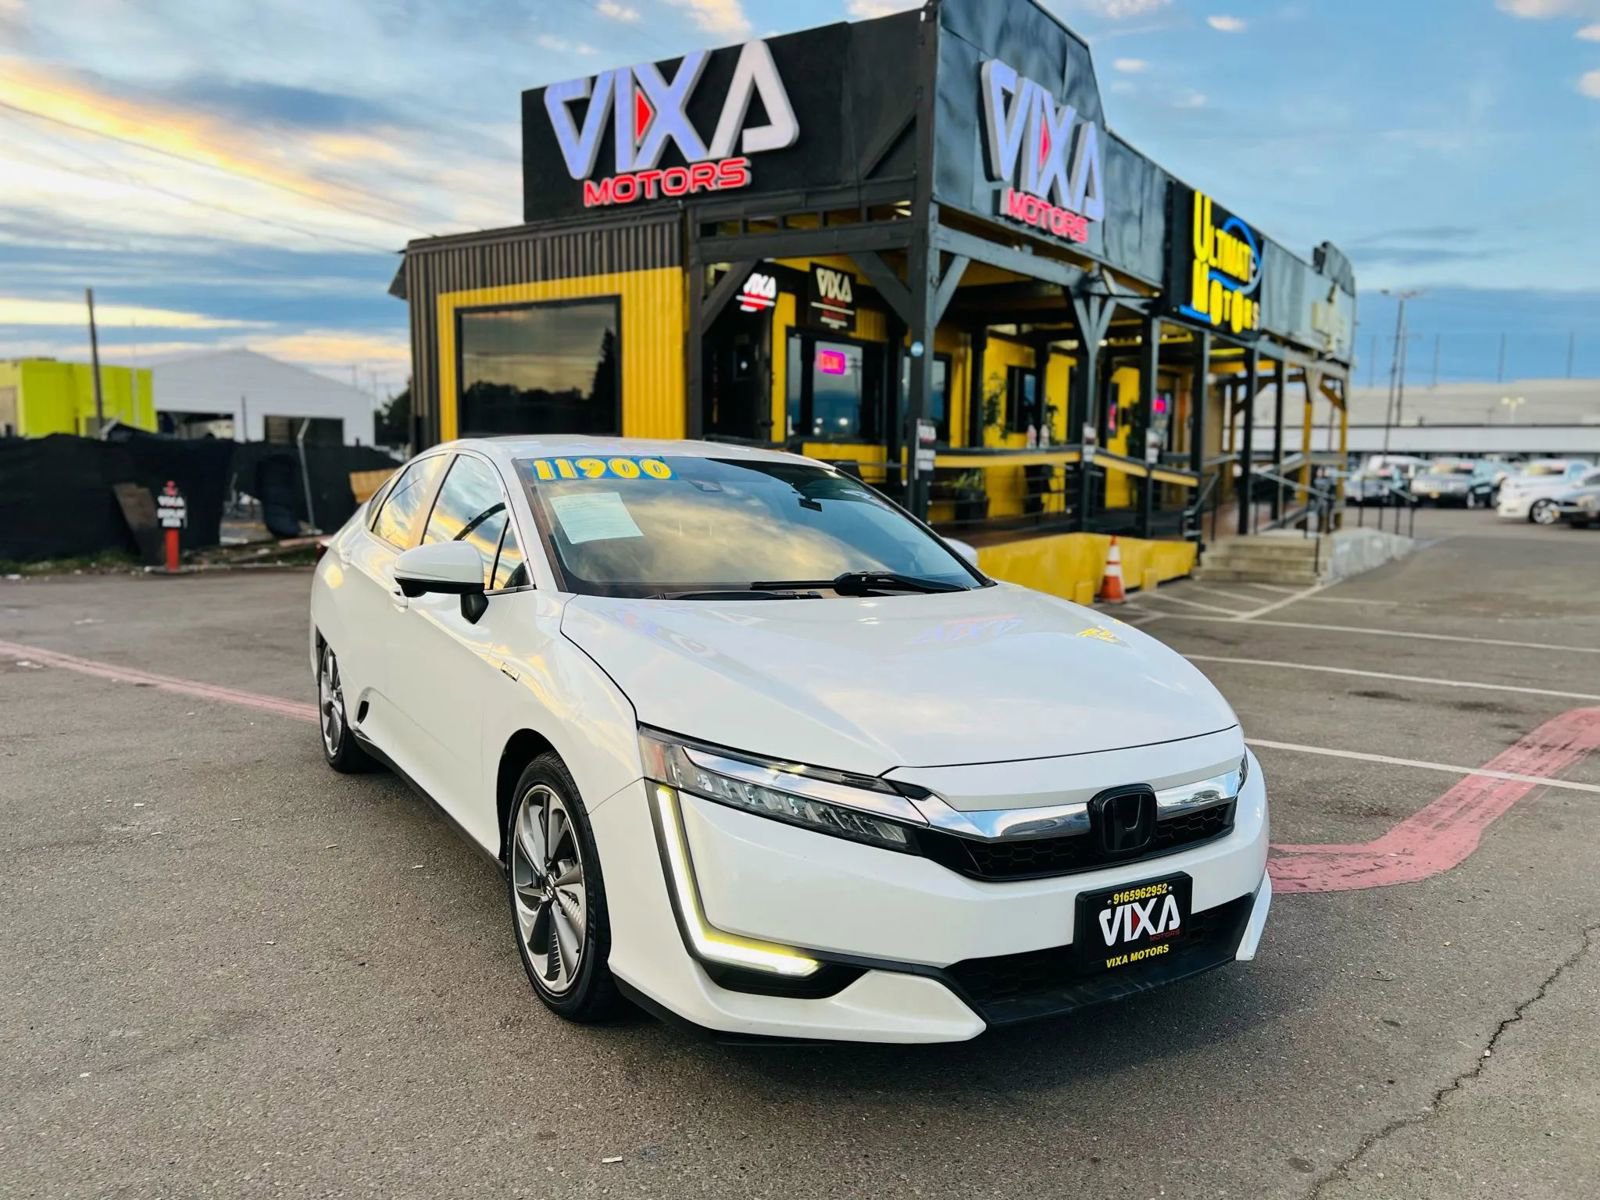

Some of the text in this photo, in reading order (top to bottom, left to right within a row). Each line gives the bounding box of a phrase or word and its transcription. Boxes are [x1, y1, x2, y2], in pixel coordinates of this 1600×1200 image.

[544, 39, 800, 181] VIXA
[981, 58, 1104, 222] VIXA
[584, 157, 751, 208] MOTORS
[1005, 187, 1088, 244] MOTORS
[533, 457, 673, 481] 11900
[1113, 883, 1168, 905] 9165962952
[1099, 894, 1181, 947] VIXA
[1106, 944, 1170, 968] VIXA MOTORS
